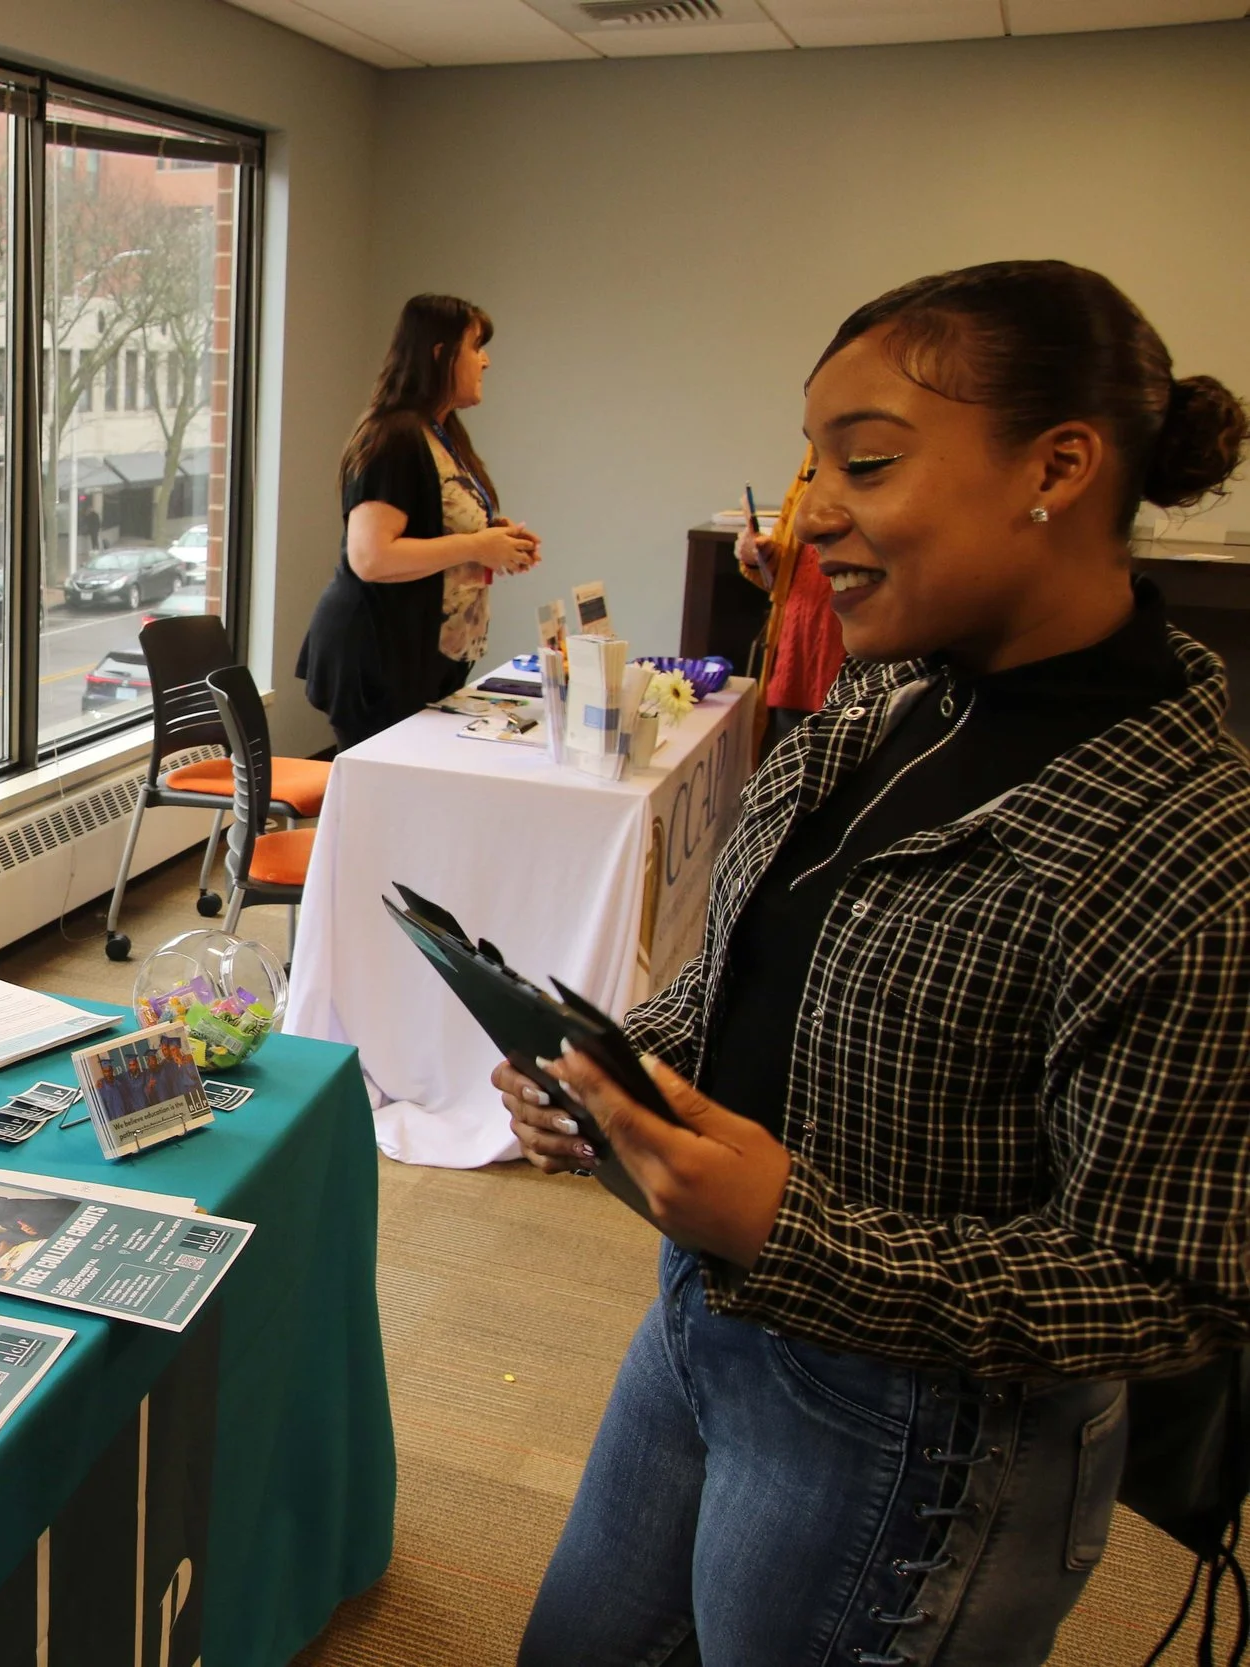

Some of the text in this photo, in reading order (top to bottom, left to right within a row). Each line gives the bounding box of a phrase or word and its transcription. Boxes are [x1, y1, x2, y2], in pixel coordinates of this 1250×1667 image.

[112, 1122, 124, 1131] We
[122, 1113, 144, 1127] believe
[142, 1104, 170, 1120] education
[173, 1099, 184, 1108] the
[15, 1267, 51, 1288] FREE
[33, 1236, 82, 1269] COLLEGE
[63, 1205, 111, 1237] CREDITS
[59, 1258, 100, 1297] DEVELOPMENTAL
[68, 1267, 102, 1299] PSYCHOLOGY
[3, 1339, 30, 1362] RCP
